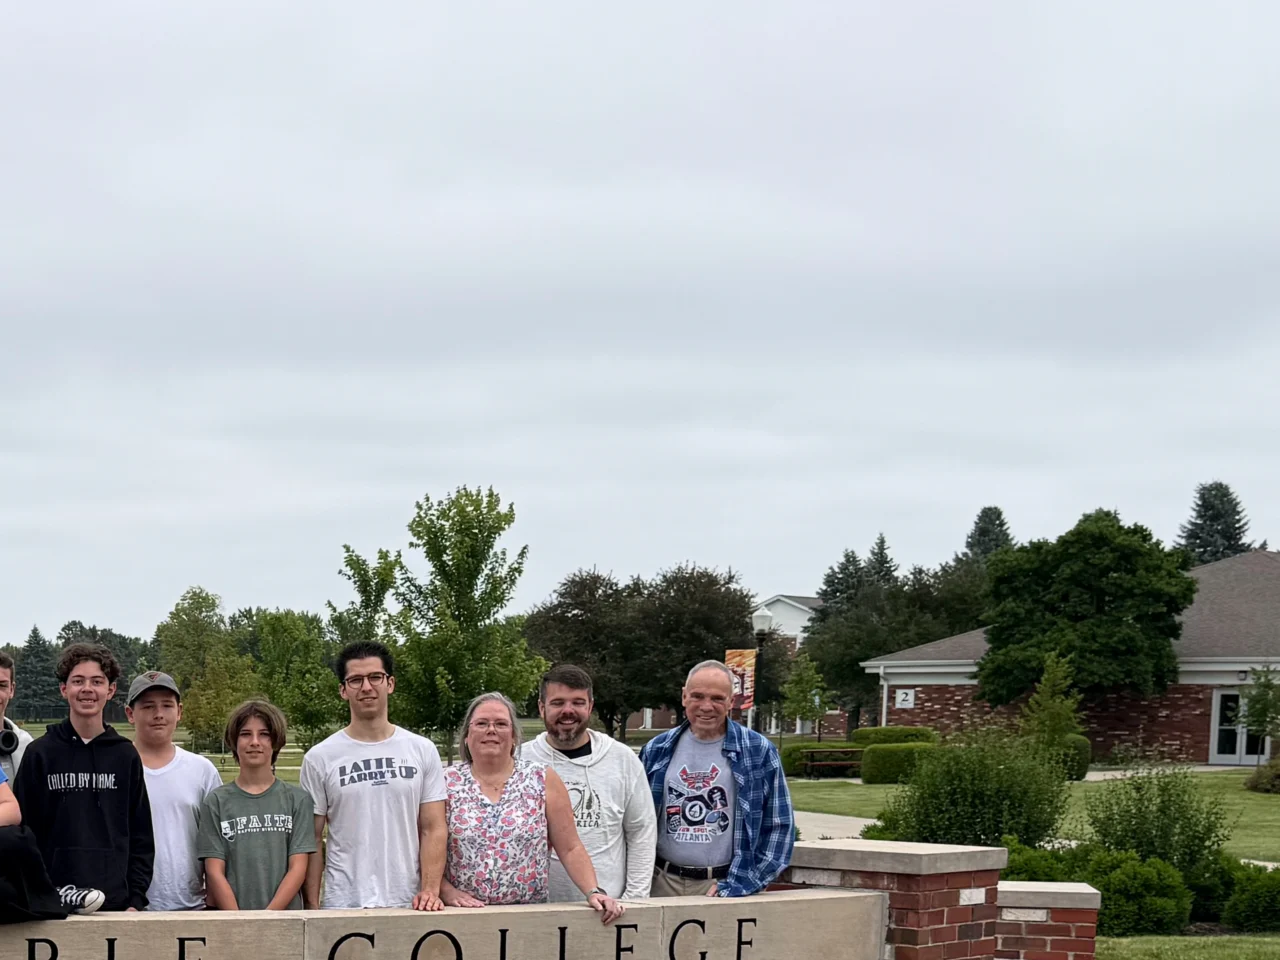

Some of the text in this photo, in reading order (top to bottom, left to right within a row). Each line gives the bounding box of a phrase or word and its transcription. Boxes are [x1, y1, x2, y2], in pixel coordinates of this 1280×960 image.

[901, 691, 910, 702] 2
[339, 757, 396, 777] LATTE
[47, 772, 76, 790] CALLED
[78, 772, 90, 788] BY
[340, 769, 398, 788] LARRY'S
[675, 832, 711, 842] ATLANTA
